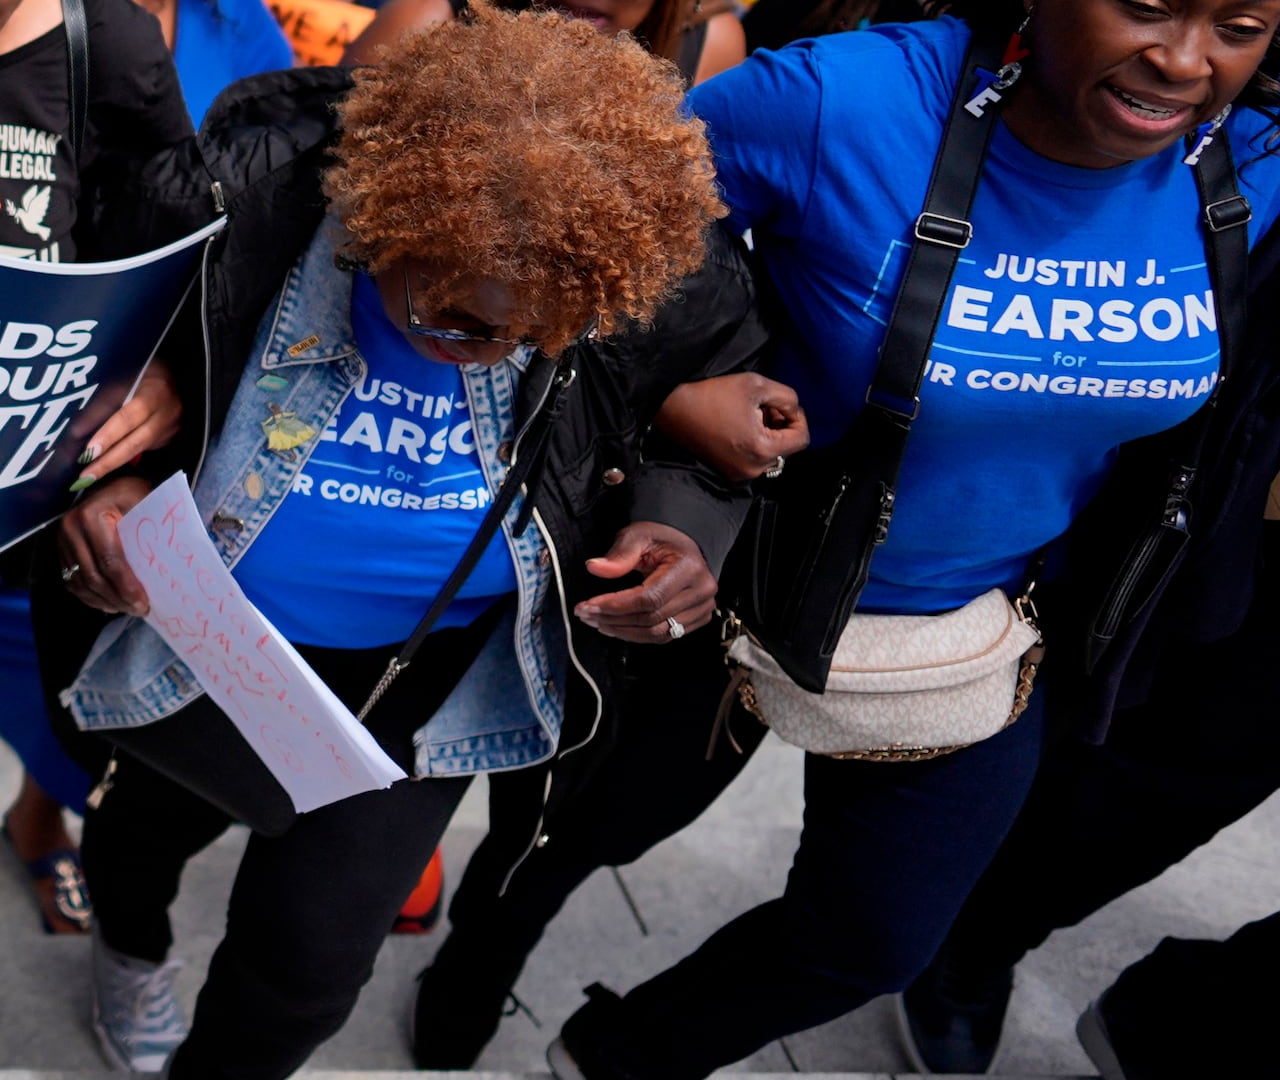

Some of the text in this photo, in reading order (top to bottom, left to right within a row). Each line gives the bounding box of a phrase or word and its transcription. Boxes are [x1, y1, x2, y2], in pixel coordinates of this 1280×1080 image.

[983, 253, 1166, 288] JUSTIN J.
[946, 284, 1218, 343] EARSON
[1052, 351, 1087, 368] for
[352, 378, 454, 419] USTIN
[385, 465, 415, 486] for
[319, 478, 495, 512] CONGRESSM
